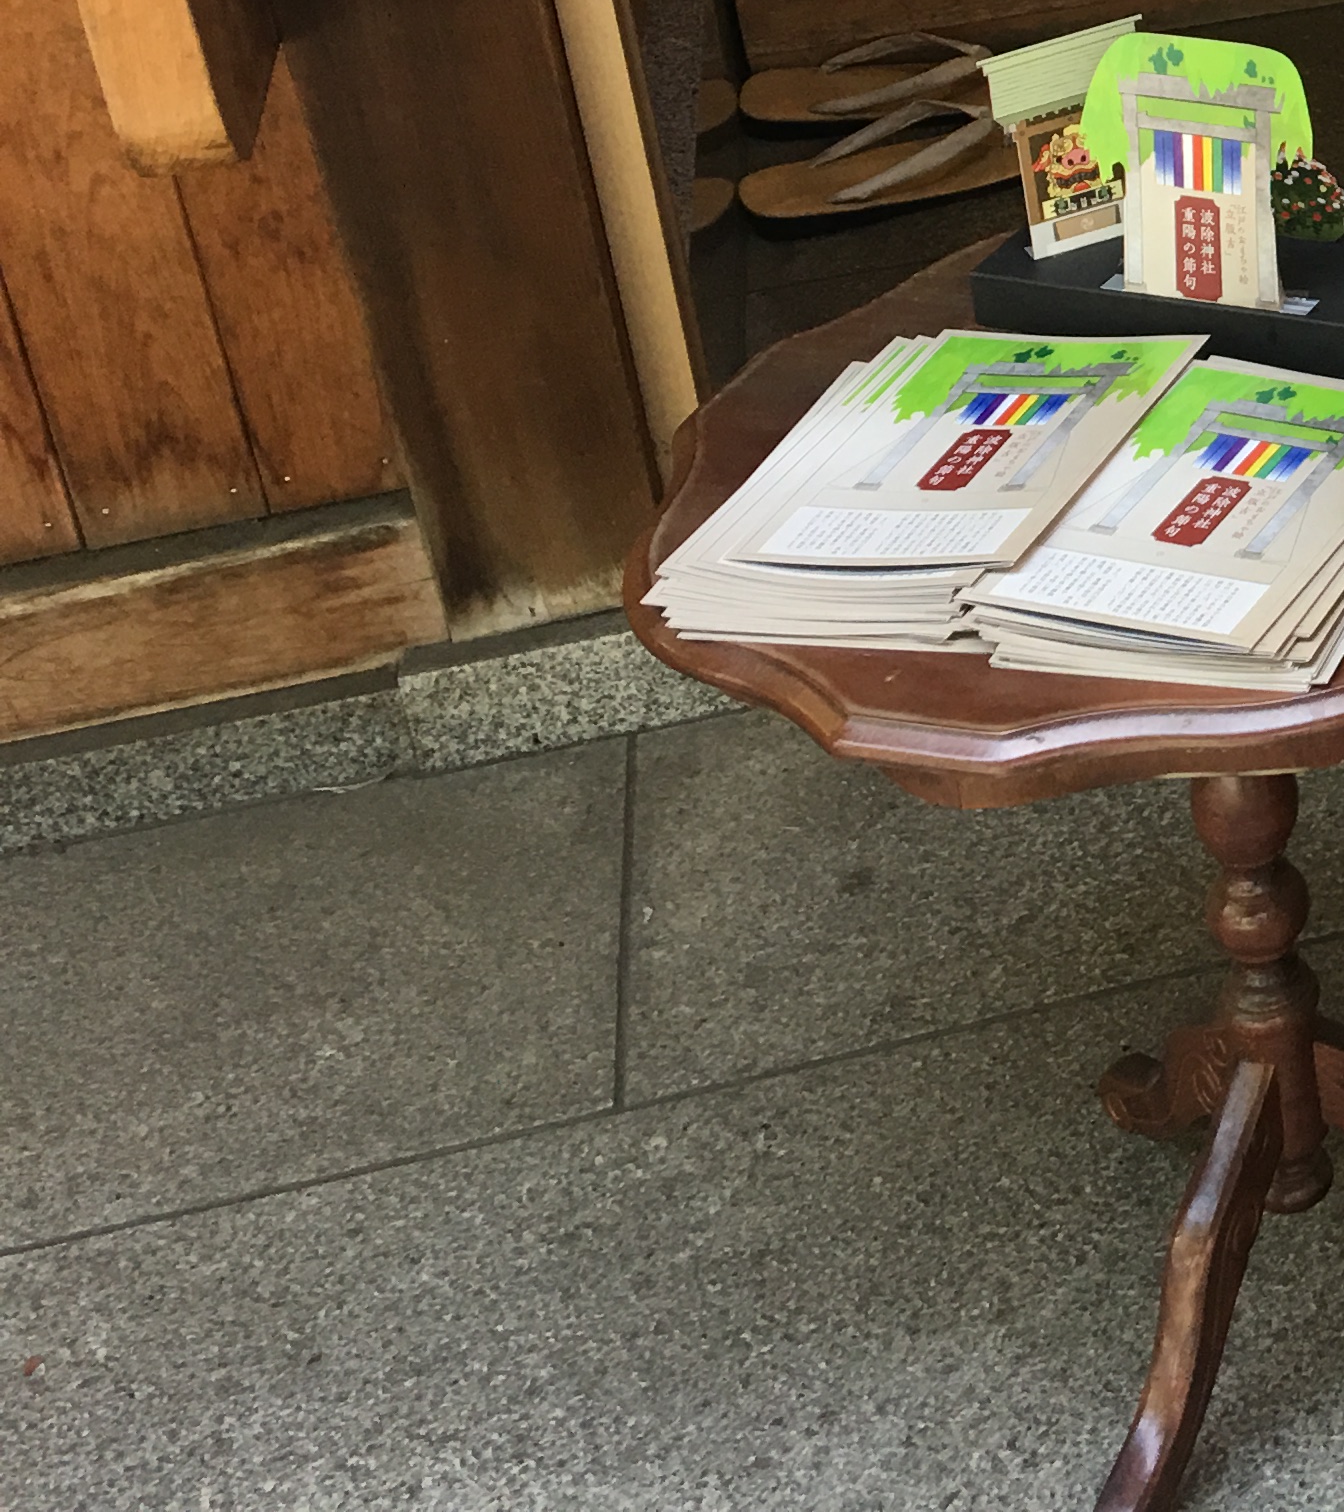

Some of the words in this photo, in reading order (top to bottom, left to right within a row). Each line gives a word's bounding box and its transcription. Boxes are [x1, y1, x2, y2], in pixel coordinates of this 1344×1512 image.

[1181, 207, 1197, 291] 重陽の節句
[1200, 208, 1216, 275] 波除神社
[928, 434, 983, 486] 重陽の節句
[956, 434, 1003, 476] 波除神社
[1164, 483, 1221, 538] 重陽の節句
[1192, 485, 1242, 530] 波除神社
